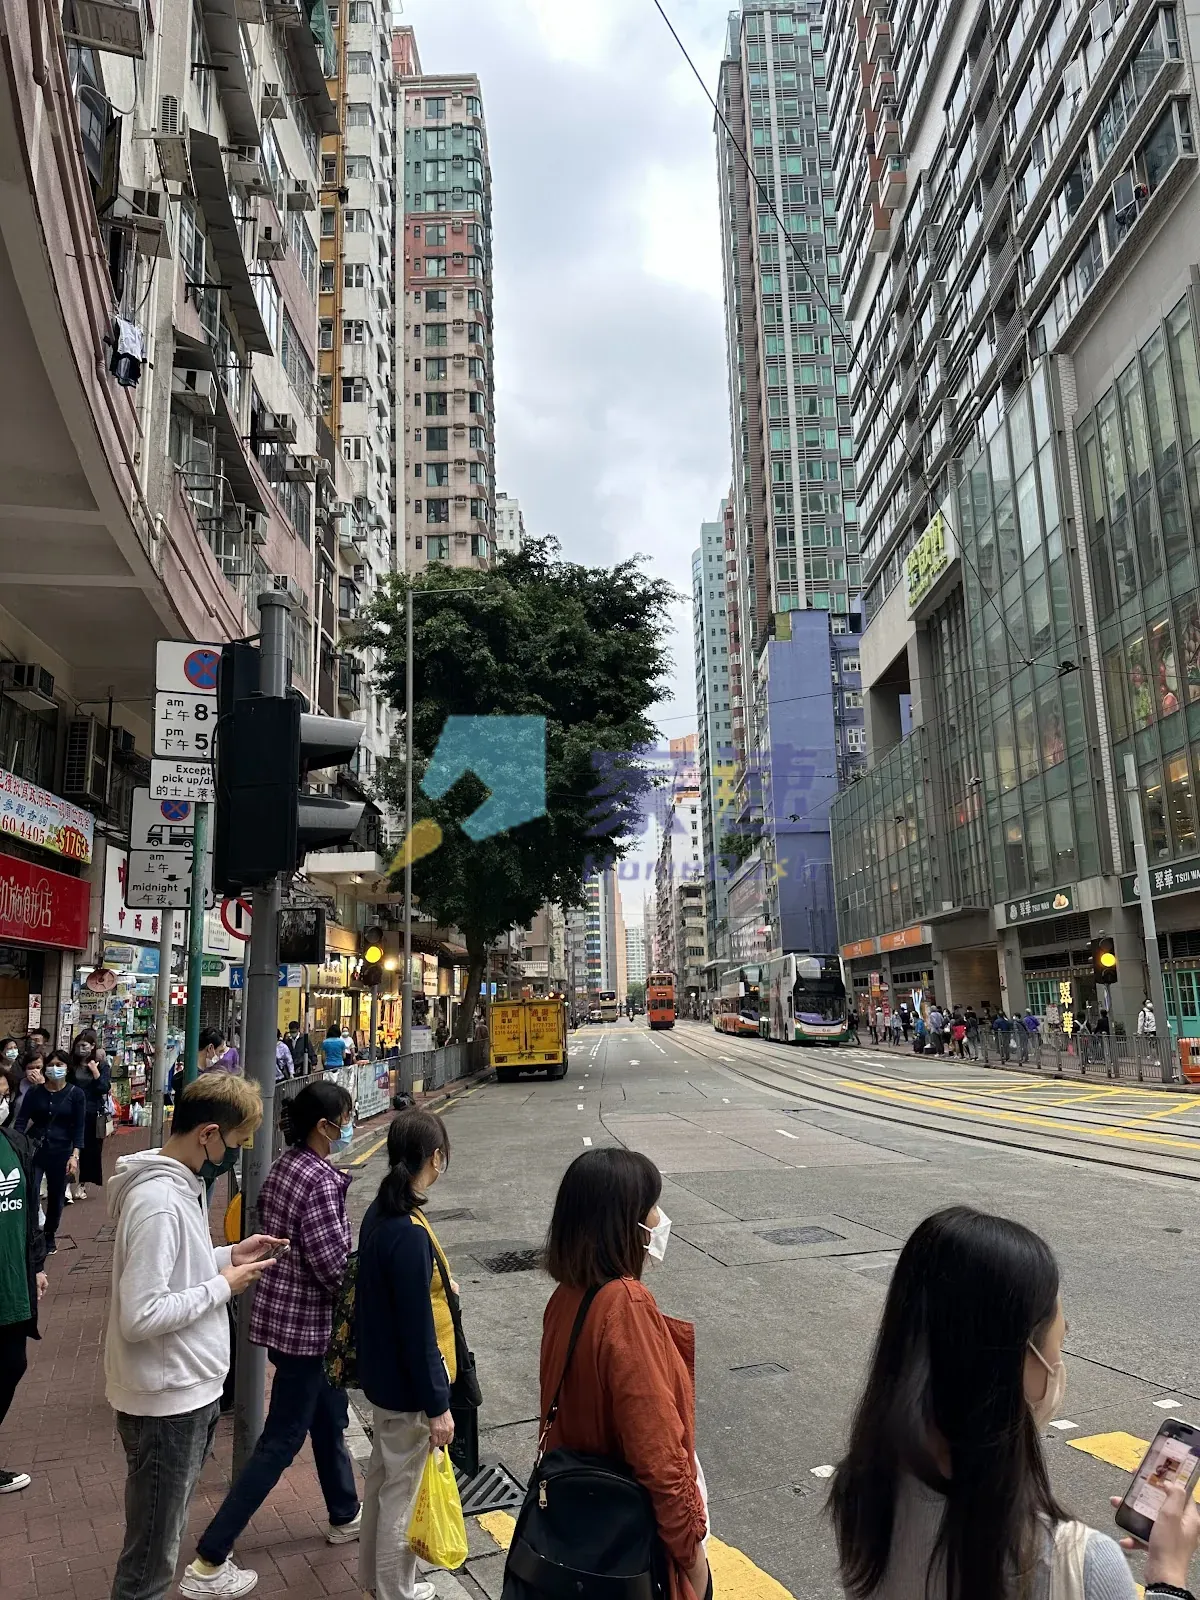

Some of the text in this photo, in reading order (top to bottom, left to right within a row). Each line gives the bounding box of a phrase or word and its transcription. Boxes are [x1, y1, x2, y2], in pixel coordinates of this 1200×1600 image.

[161, 709, 189, 721] 上午
[166, 728, 184, 737] pm
[161, 739, 189, 750] 下午
[176, 765, 211, 776] Except
[162, 774, 183, 783] pick
[20, 821, 45, 844] 4405
[59, 827, 86, 859] $1763
[144, 863, 169, 873] 上午
[1154, 868, 1174, 891] 翠華
[1175, 871, 1190, 883] TSUI
[132, 883, 178, 892] midnight
[139, 894, 167, 904] 午夜
[1019, 900, 1031, 917] 翠華
[1032, 904, 1040, 912] TSUI
[1060, 981, 1073, 1038] 翠華
[0, 1197, 23, 1212] das
